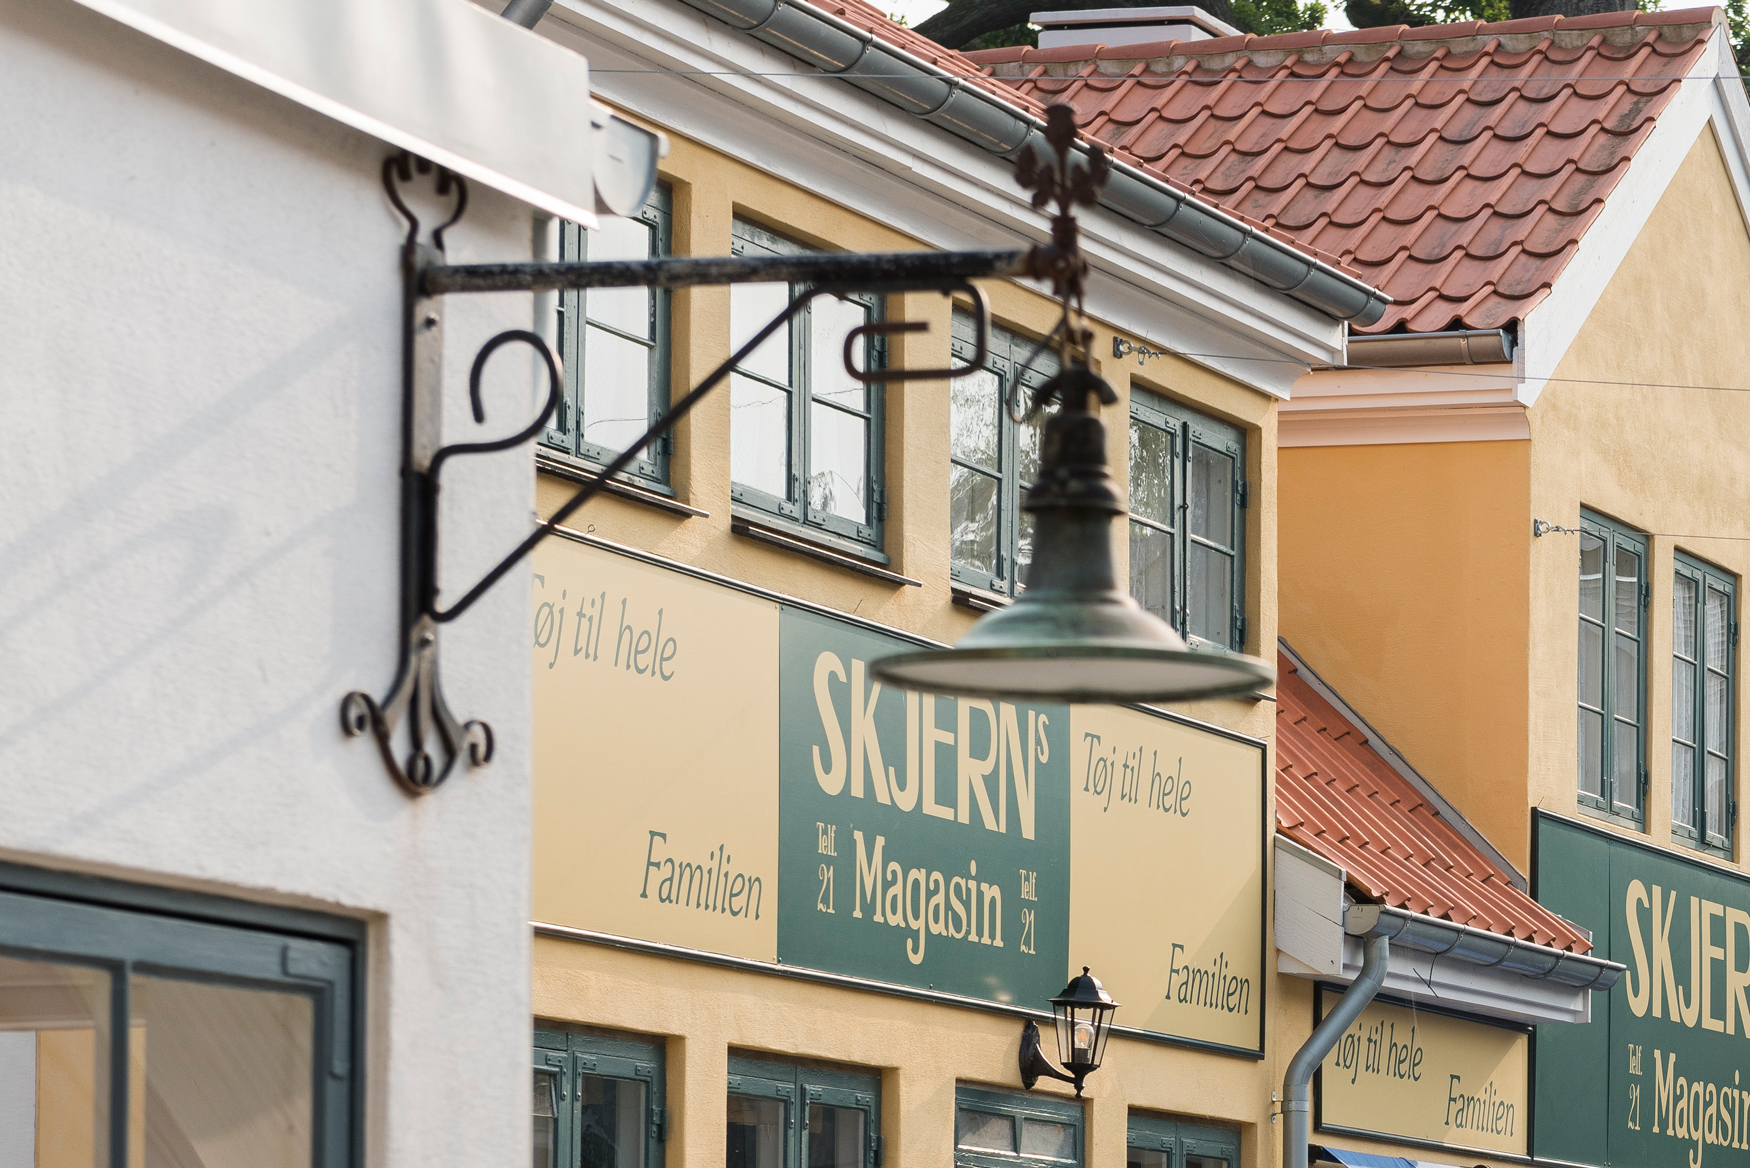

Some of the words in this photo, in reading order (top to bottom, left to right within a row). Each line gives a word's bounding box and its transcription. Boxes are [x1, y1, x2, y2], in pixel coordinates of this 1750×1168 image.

[574, 591, 606, 662] til
[614, 597, 677, 681] hele
[1083, 732, 1116, 813] Tøj
[1121, 746, 1143, 804] til
[1149, 749, 1191, 817] hele
[816, 821, 837, 857] Telf.
[640, 830, 762, 921] Familien
[817, 863, 835, 914] 21
[853, 830, 1004, 965] Magasin
[1020, 908, 1036, 955] 21
[1165, 943, 1249, 1016] Familien
[1365, 1019, 1385, 1075] til
[1387, 1022, 1423, 1082] hele
[1444, 1073, 1515, 1137] Familien
[1627, 1083, 1640, 1131] 21
